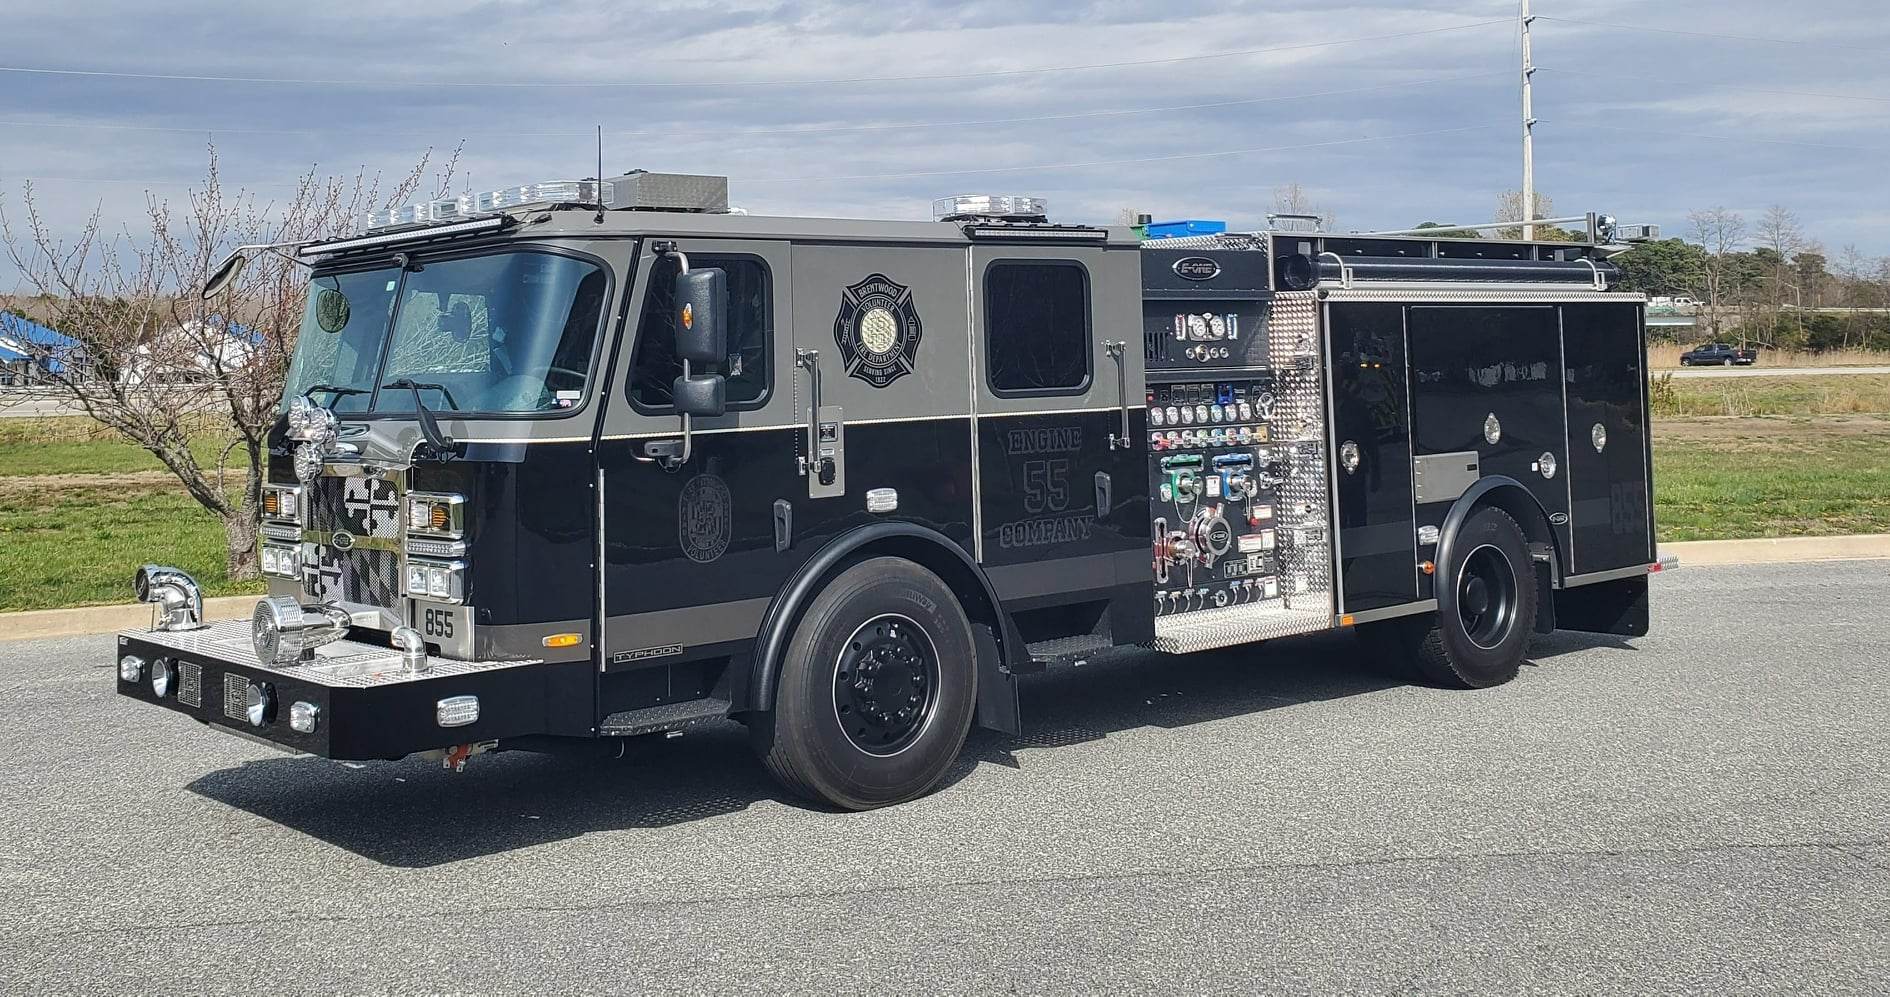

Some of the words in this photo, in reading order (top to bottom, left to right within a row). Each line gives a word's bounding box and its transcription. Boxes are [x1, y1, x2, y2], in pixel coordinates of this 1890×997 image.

[858, 282, 898, 299] BRENTWOOD
[861, 298, 896, 312] VOLUNTEER
[867, 340, 903, 363] DEPARTMENT
[863, 364, 883, 376] SERVING
[884, 364, 897, 376] SINCE
[1008, 426, 1082, 455] ENGINE
[1023, 459, 1070, 512] 55
[1000, 515, 1095, 548] COMPANY
[687, 539, 727, 560] VOLUNTEER
[425, 608, 454, 639] 855
[616, 646, 681, 660] TYPHOON
